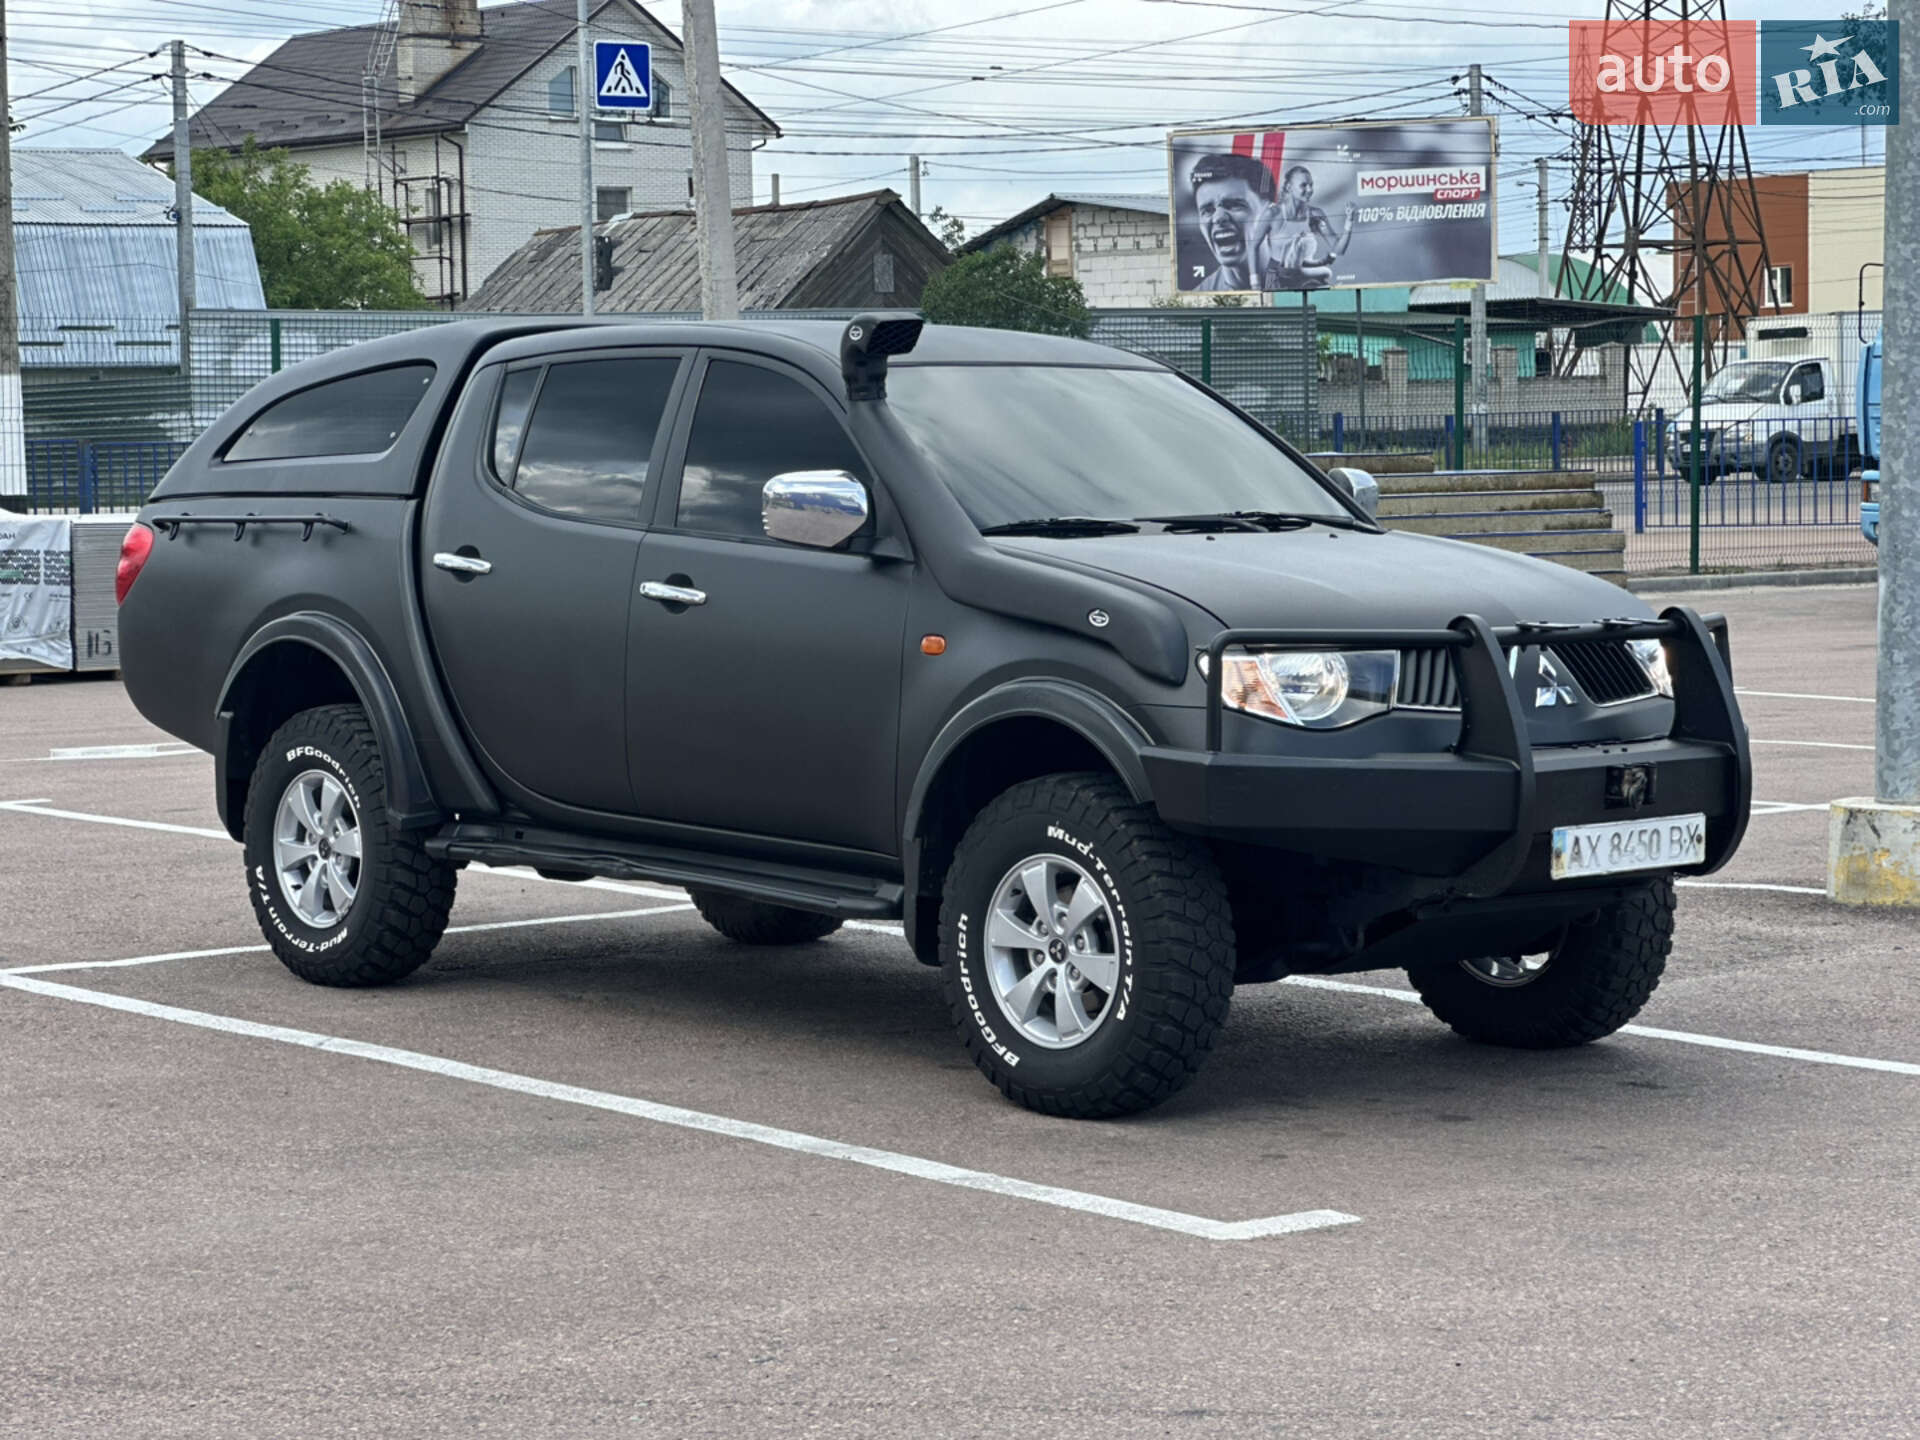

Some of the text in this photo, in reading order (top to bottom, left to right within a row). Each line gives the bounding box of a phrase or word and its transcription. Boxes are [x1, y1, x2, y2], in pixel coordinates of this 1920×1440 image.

[1358, 202, 1486, 223] 100% ВІДНОВЛЕННЯ
[1361, 170, 1481, 192] моршинська
[286, 746, 361, 809] BFGoodrich
[1567, 823, 1700, 870] AX 8450 BX
[255, 865, 348, 953] Mud-Terrain T/A
[1047, 825, 1133, 1021] Mud-Terrain T/A
[957, 913, 1020, 1067] BFGoodrich
